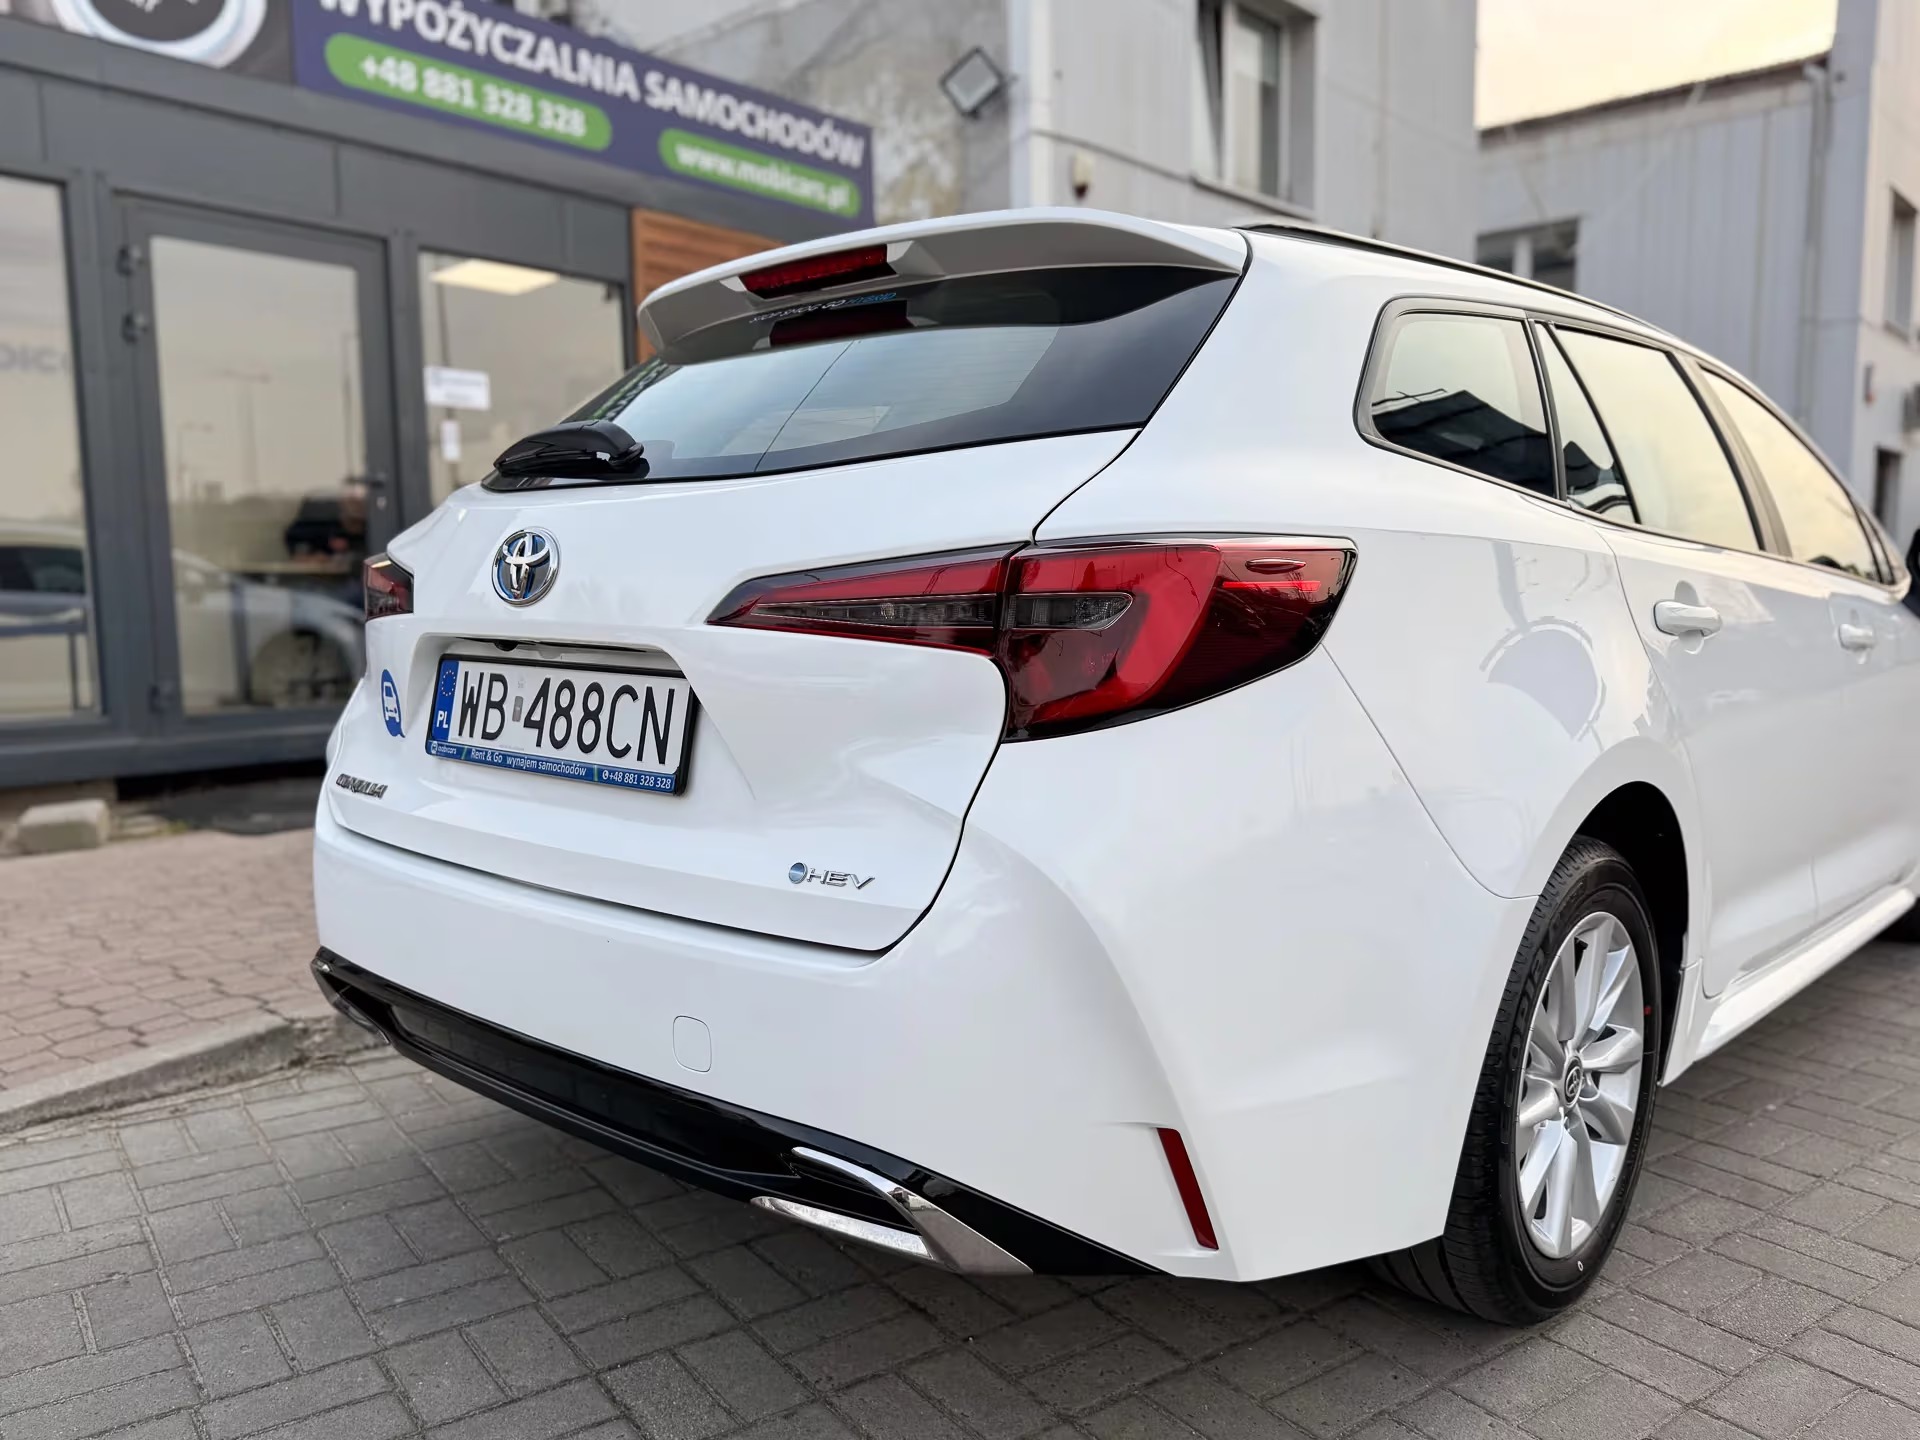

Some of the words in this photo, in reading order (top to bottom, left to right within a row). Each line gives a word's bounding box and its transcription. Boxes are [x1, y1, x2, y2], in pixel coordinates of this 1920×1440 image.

[360, 55, 418, 93] +48
[422, 67, 478, 109] 881
[481, 83, 534, 124] 328
[537, 100, 587, 137] 328
[644, 70, 866, 168] SAMOCHODÓW
[436, 710, 449, 729] PL
[458, 671, 509, 741] WB
[523, 677, 676, 765] 488CN
[470, 748, 485, 760] Rent
[486, 750, 492, 761] &
[493, 752, 503, 764] Go
[506, 756, 538, 769] wynajem
[538, 761, 587, 776] samochodów
[609, 771, 623, 782] +48
[624, 773, 638, 785] 881
[639, 775, 655, 787] 328
[655, 777, 672, 789] 328
[806, 867, 875, 890] HEV
